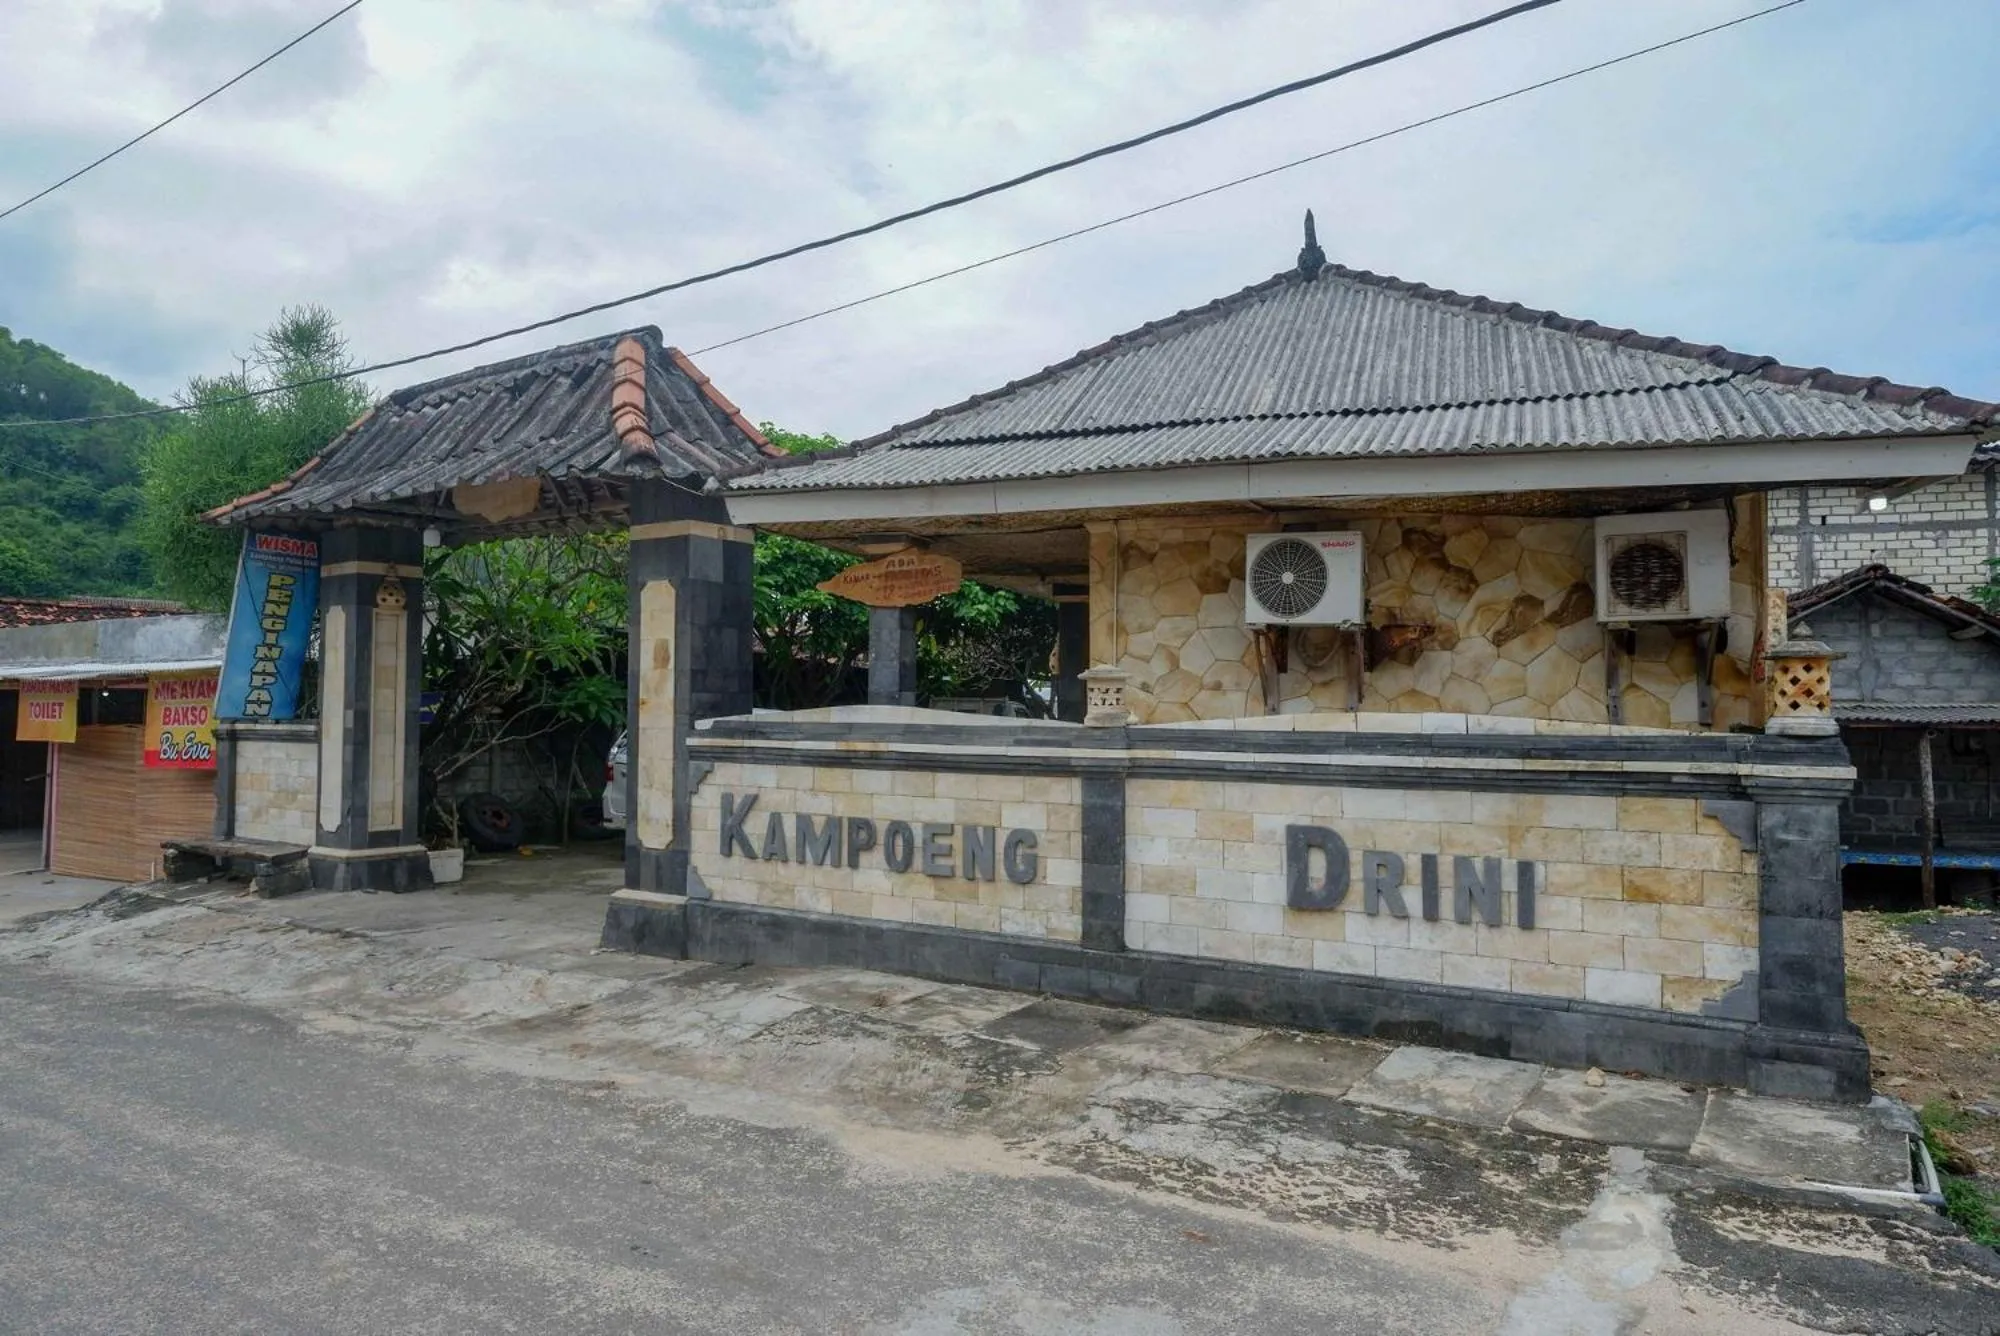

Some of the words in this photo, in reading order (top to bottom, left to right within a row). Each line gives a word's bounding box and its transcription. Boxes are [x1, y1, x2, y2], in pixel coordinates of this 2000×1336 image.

[256, 533, 318, 558] WISMA
[1320, 540, 1356, 549] SHARP
[243, 573, 296, 717] PENGINAPAN
[155, 680, 177, 700] MIE
[180, 678, 218, 699] AYAM
[29, 701, 65, 720] TOILET
[161, 705, 208, 727] BAKSO
[160, 731, 179, 760] Bu
[181, 731, 212, 760] Eva
[719, 791, 1038, 885] KAMPOENG
[1285, 824, 1535, 930] DRINI
